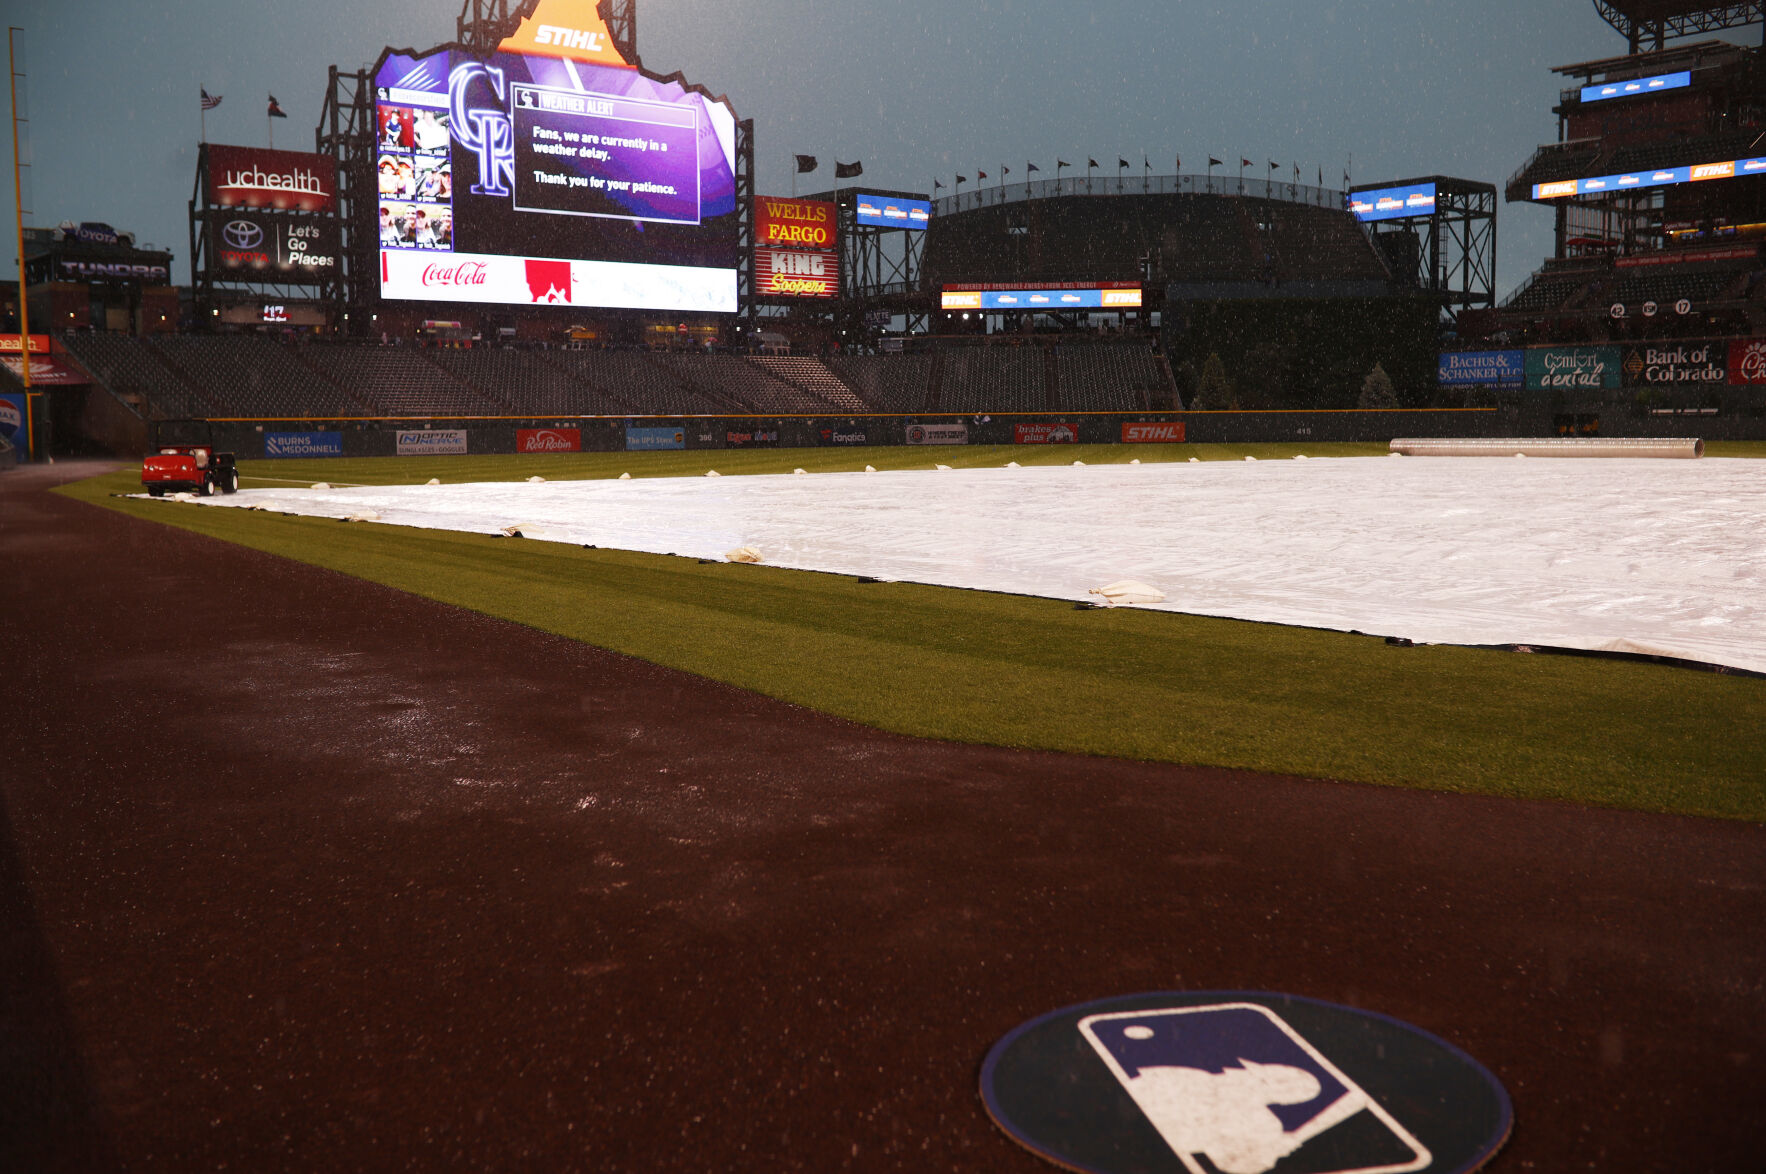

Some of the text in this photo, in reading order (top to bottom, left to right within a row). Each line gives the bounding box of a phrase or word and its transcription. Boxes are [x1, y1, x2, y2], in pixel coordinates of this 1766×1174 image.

[534, 24, 603, 52] STIHL
[541, 94, 614, 116] WEATHER ALERT
[533, 126, 667, 152] Fans, we are currently in a
[533, 142, 611, 162] weather delay.
[227, 164, 321, 192] uchealth
[1694, 164, 1732, 179] STIHL
[533, 171, 677, 196] Thank you for your patience.
[1541, 181, 1575, 196] STIHL
[766, 202, 827, 222] WELLS
[75, 228, 118, 244] TOYOTA
[288, 224, 320, 238] Let's
[768, 224, 826, 243] FARGO
[288, 238, 307, 251] Go
[221, 250, 269, 263] TOYOTA
[288, 252, 334, 266] Places
[771, 252, 825, 276] KING
[61, 261, 168, 278] TUNDRA
[770, 273, 826, 296] Soopers
[942, 295, 978, 305] STIHL
[1496, 355, 1509, 368] &
[1646, 345, 1709, 365] Bank of
[1646, 362, 1724, 382] Colorado
[1018, 425, 1051, 434] brakes
[1127, 426, 1178, 439] STIHL
[278, 437, 311, 445] BURNS
[525, 436, 571, 450] Red Robin
[832, 432, 866, 443] Fanatics
[1024, 433, 1044, 442] plus
